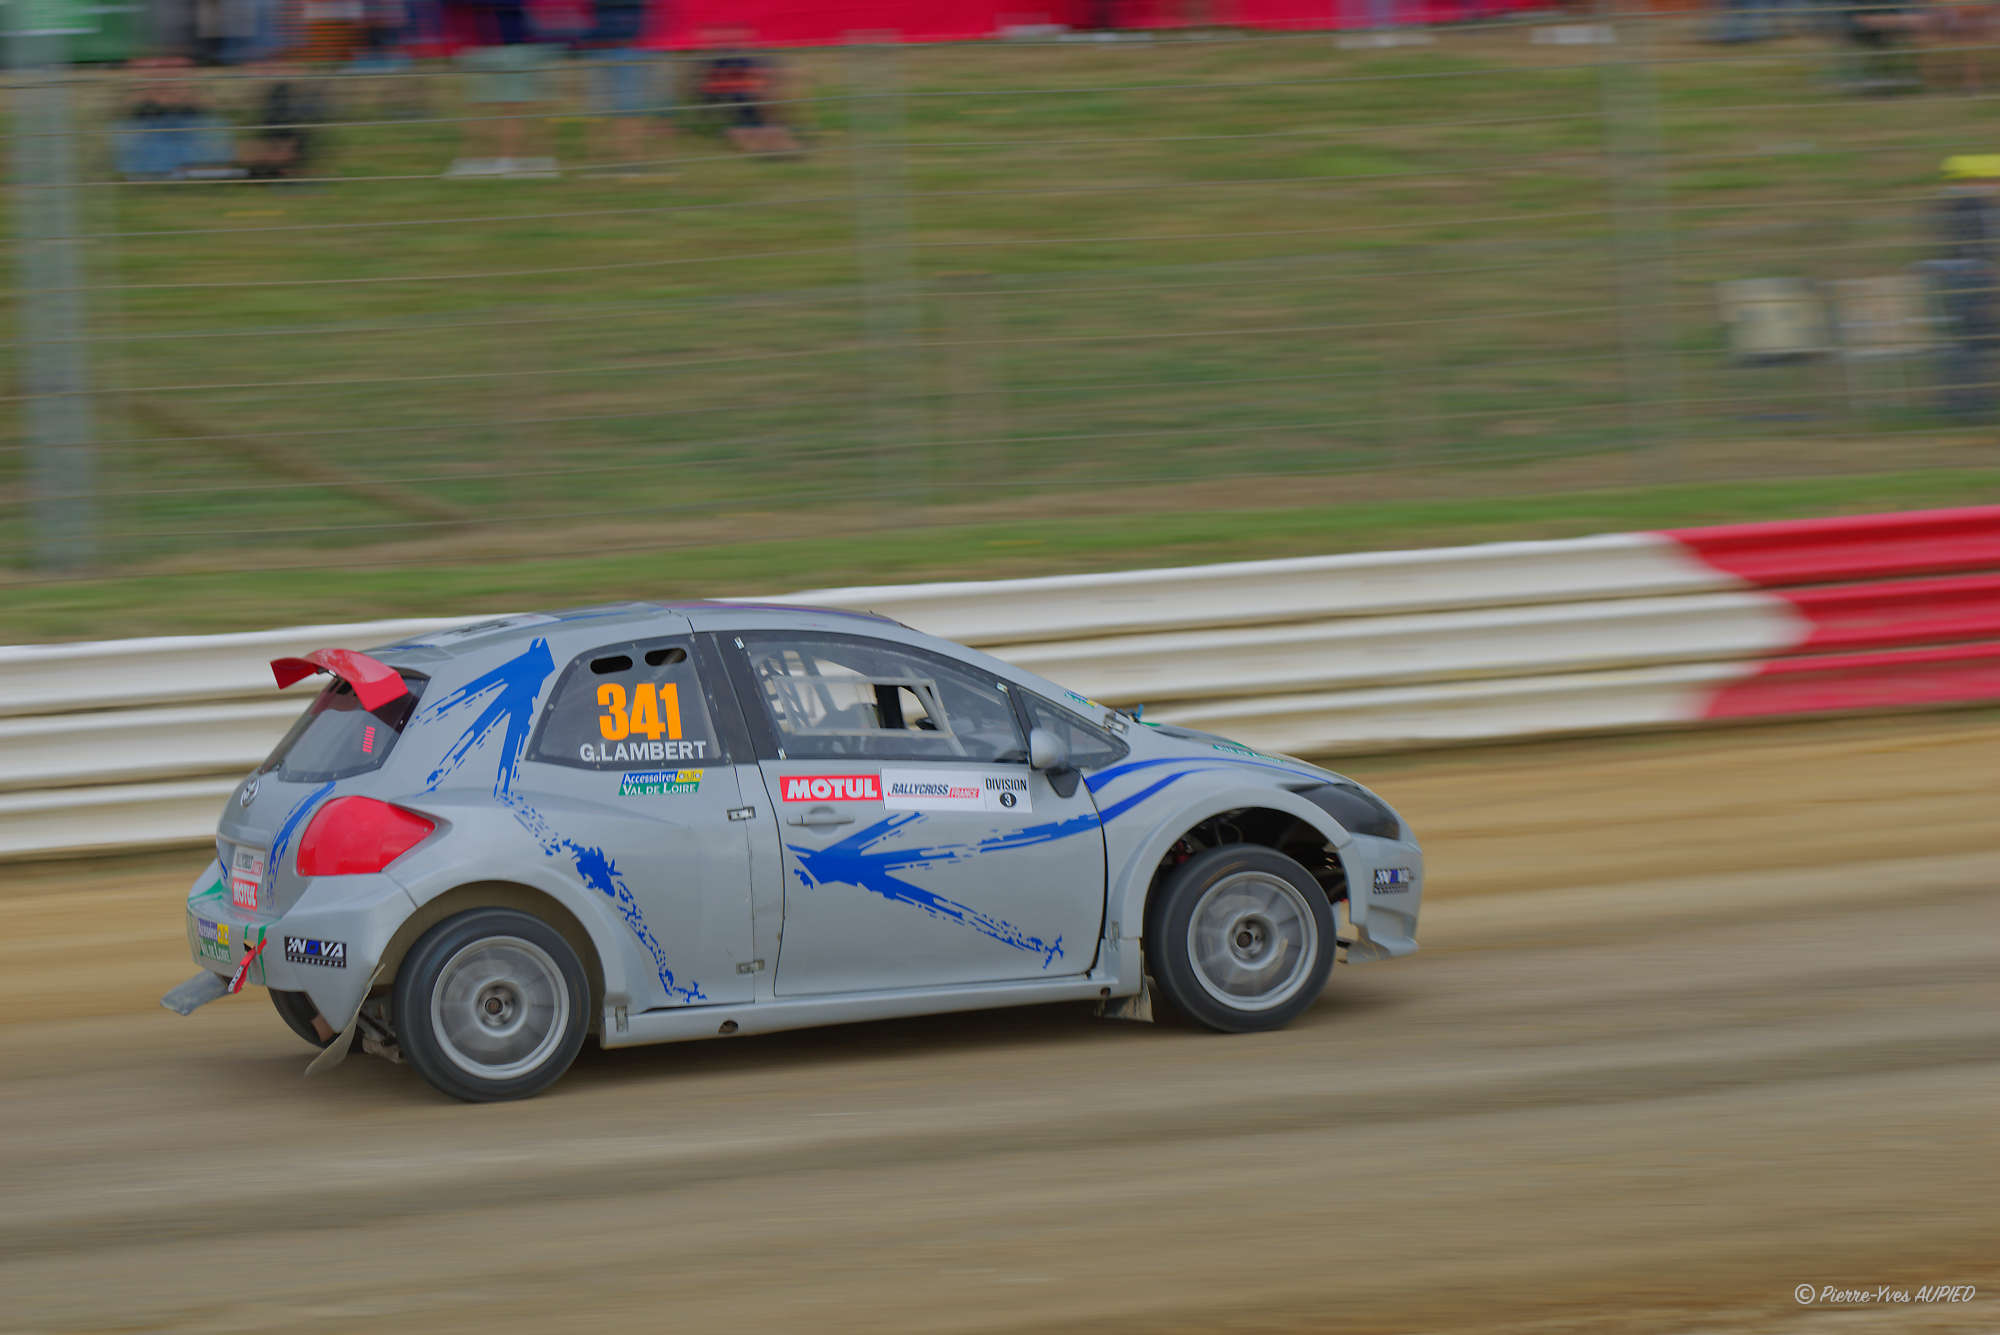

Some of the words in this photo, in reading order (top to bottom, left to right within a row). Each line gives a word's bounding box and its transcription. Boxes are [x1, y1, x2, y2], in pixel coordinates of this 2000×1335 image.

[597, 683, 682, 741] 341
[580, 741, 706, 761] G.LAMBERT
[624, 770, 676, 784] Accessoires
[985, 777, 1027, 792] DIVISION
[663, 782, 697, 794] LOIRE
[787, 778, 878, 799] MOTUL
[891, 783, 949, 795] RALLYCROSS
[233, 880, 257, 907] MOTUL
